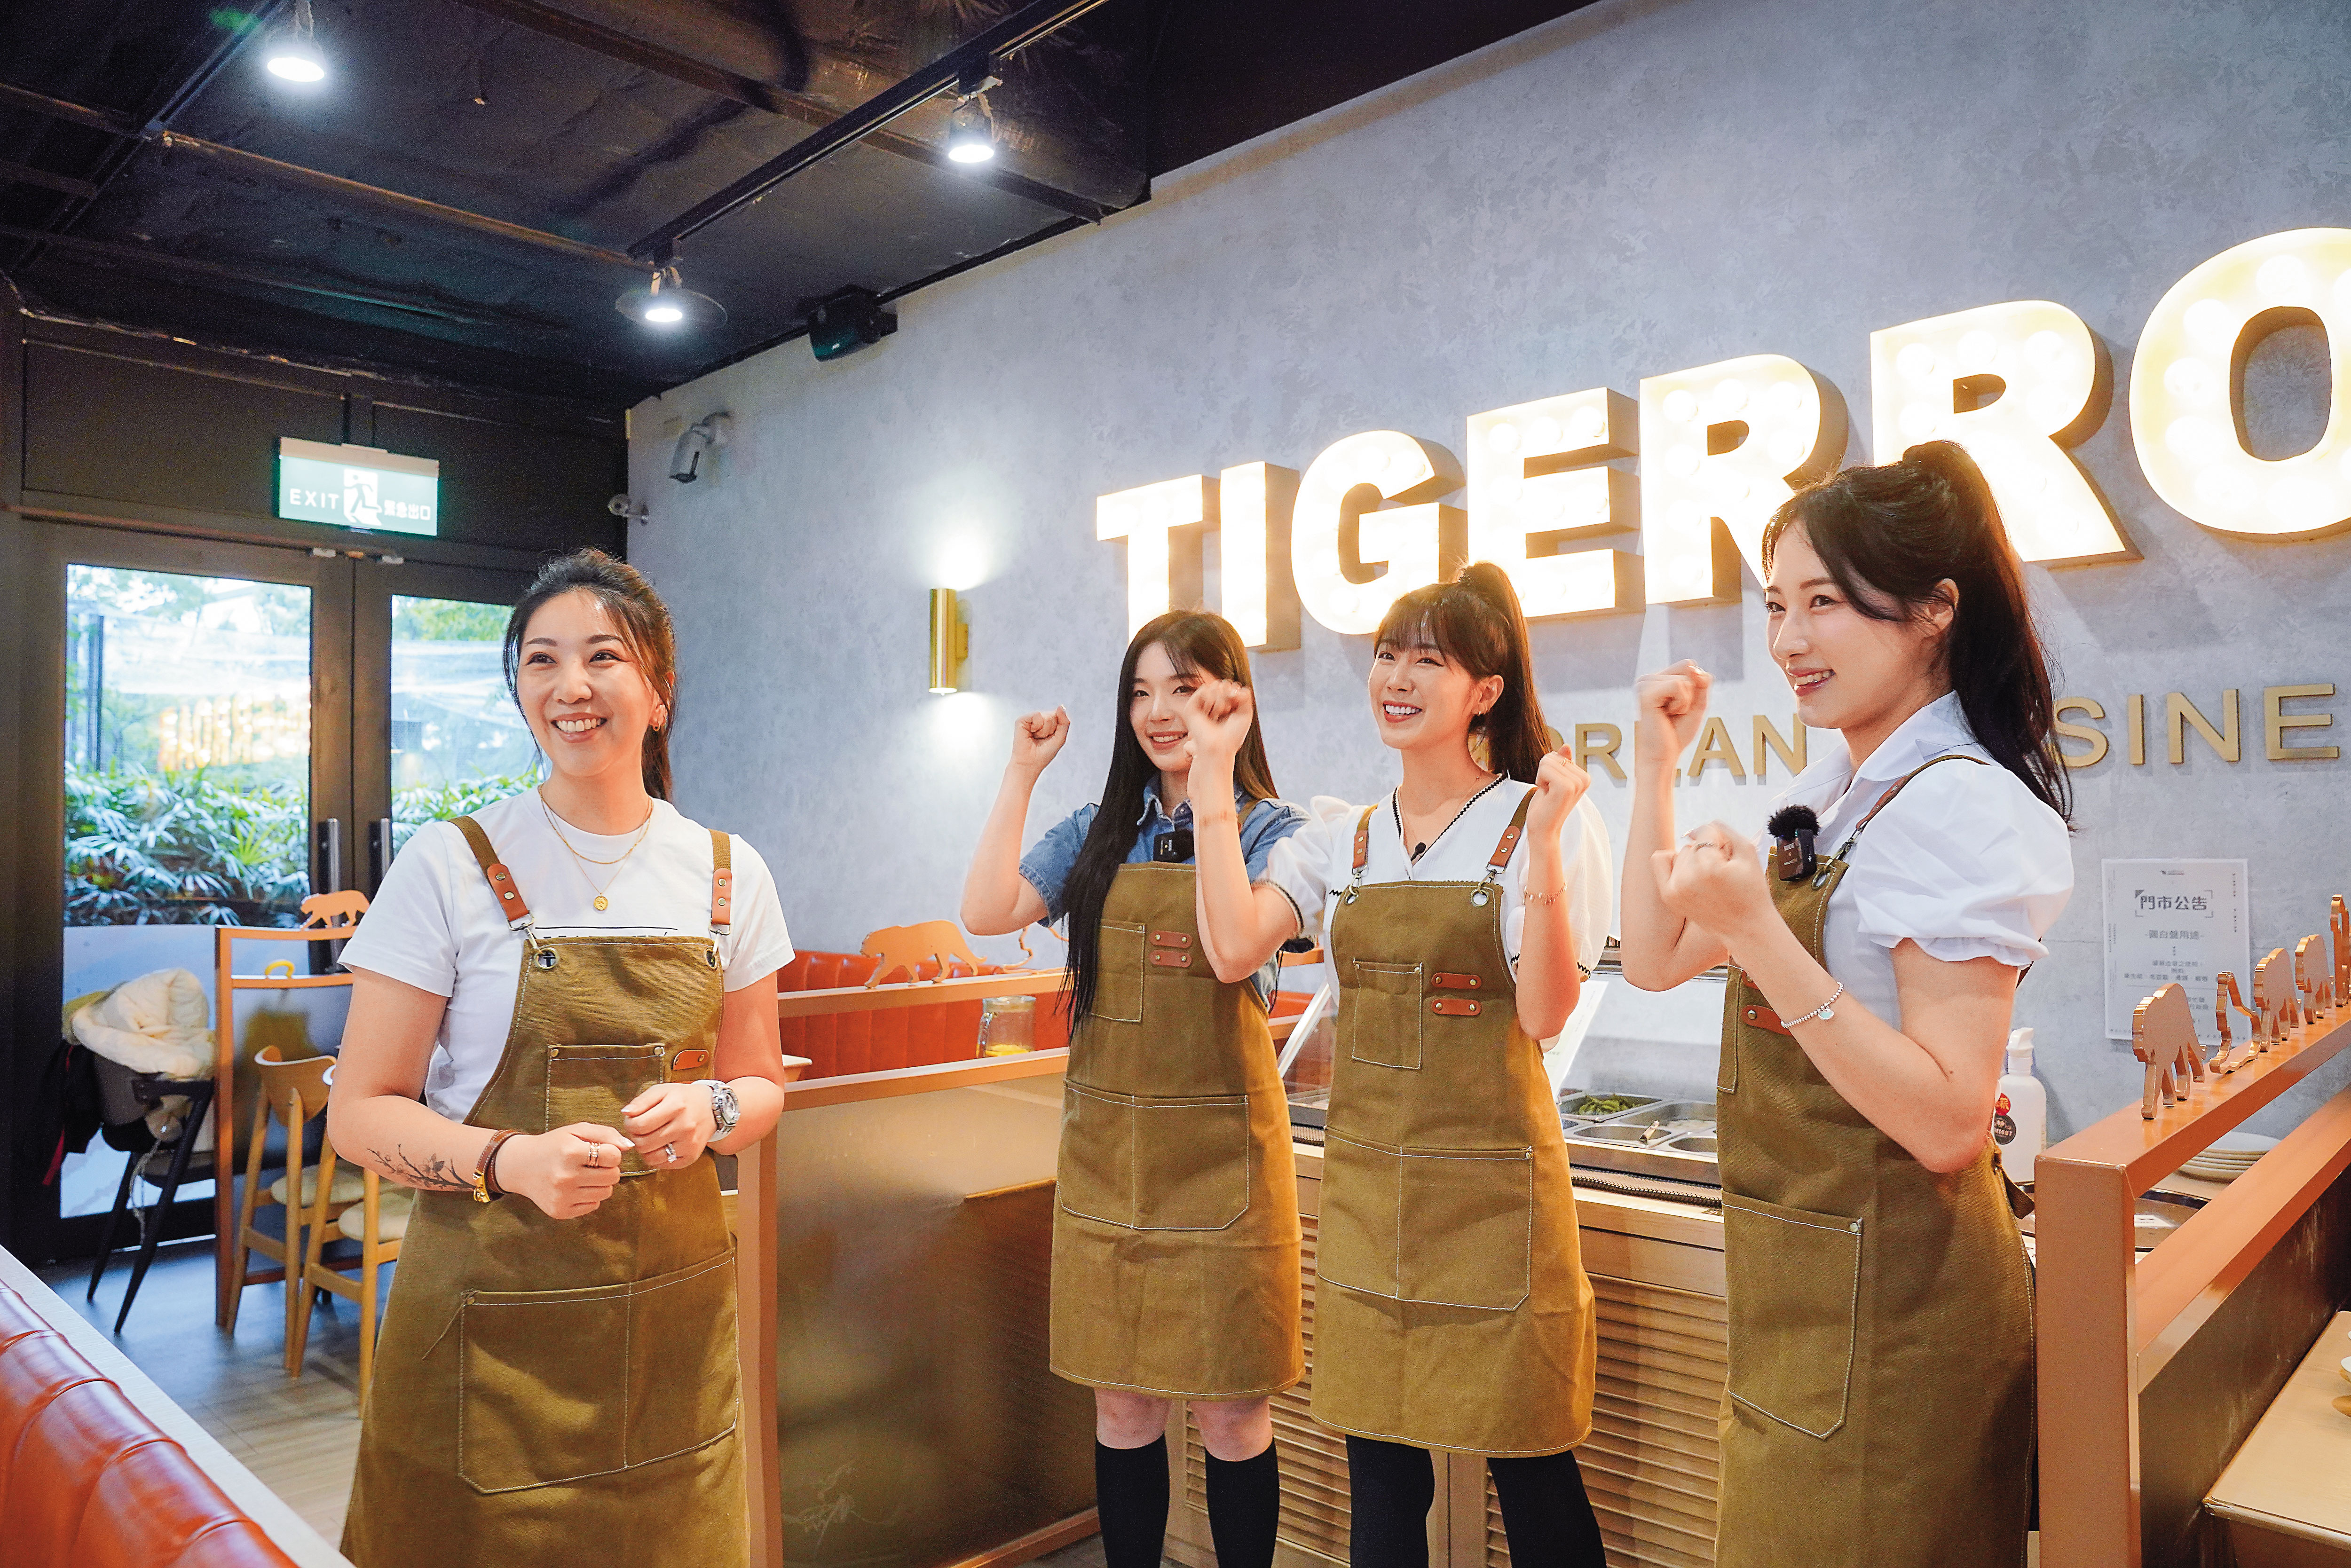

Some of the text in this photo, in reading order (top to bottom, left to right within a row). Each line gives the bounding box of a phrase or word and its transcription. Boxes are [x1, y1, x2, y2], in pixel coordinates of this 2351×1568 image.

[289, 488, 339, 510] EXIT
[1467, 683, 2340, 780] RAN SINE
[2140, 895, 2208, 910] 門市公告
